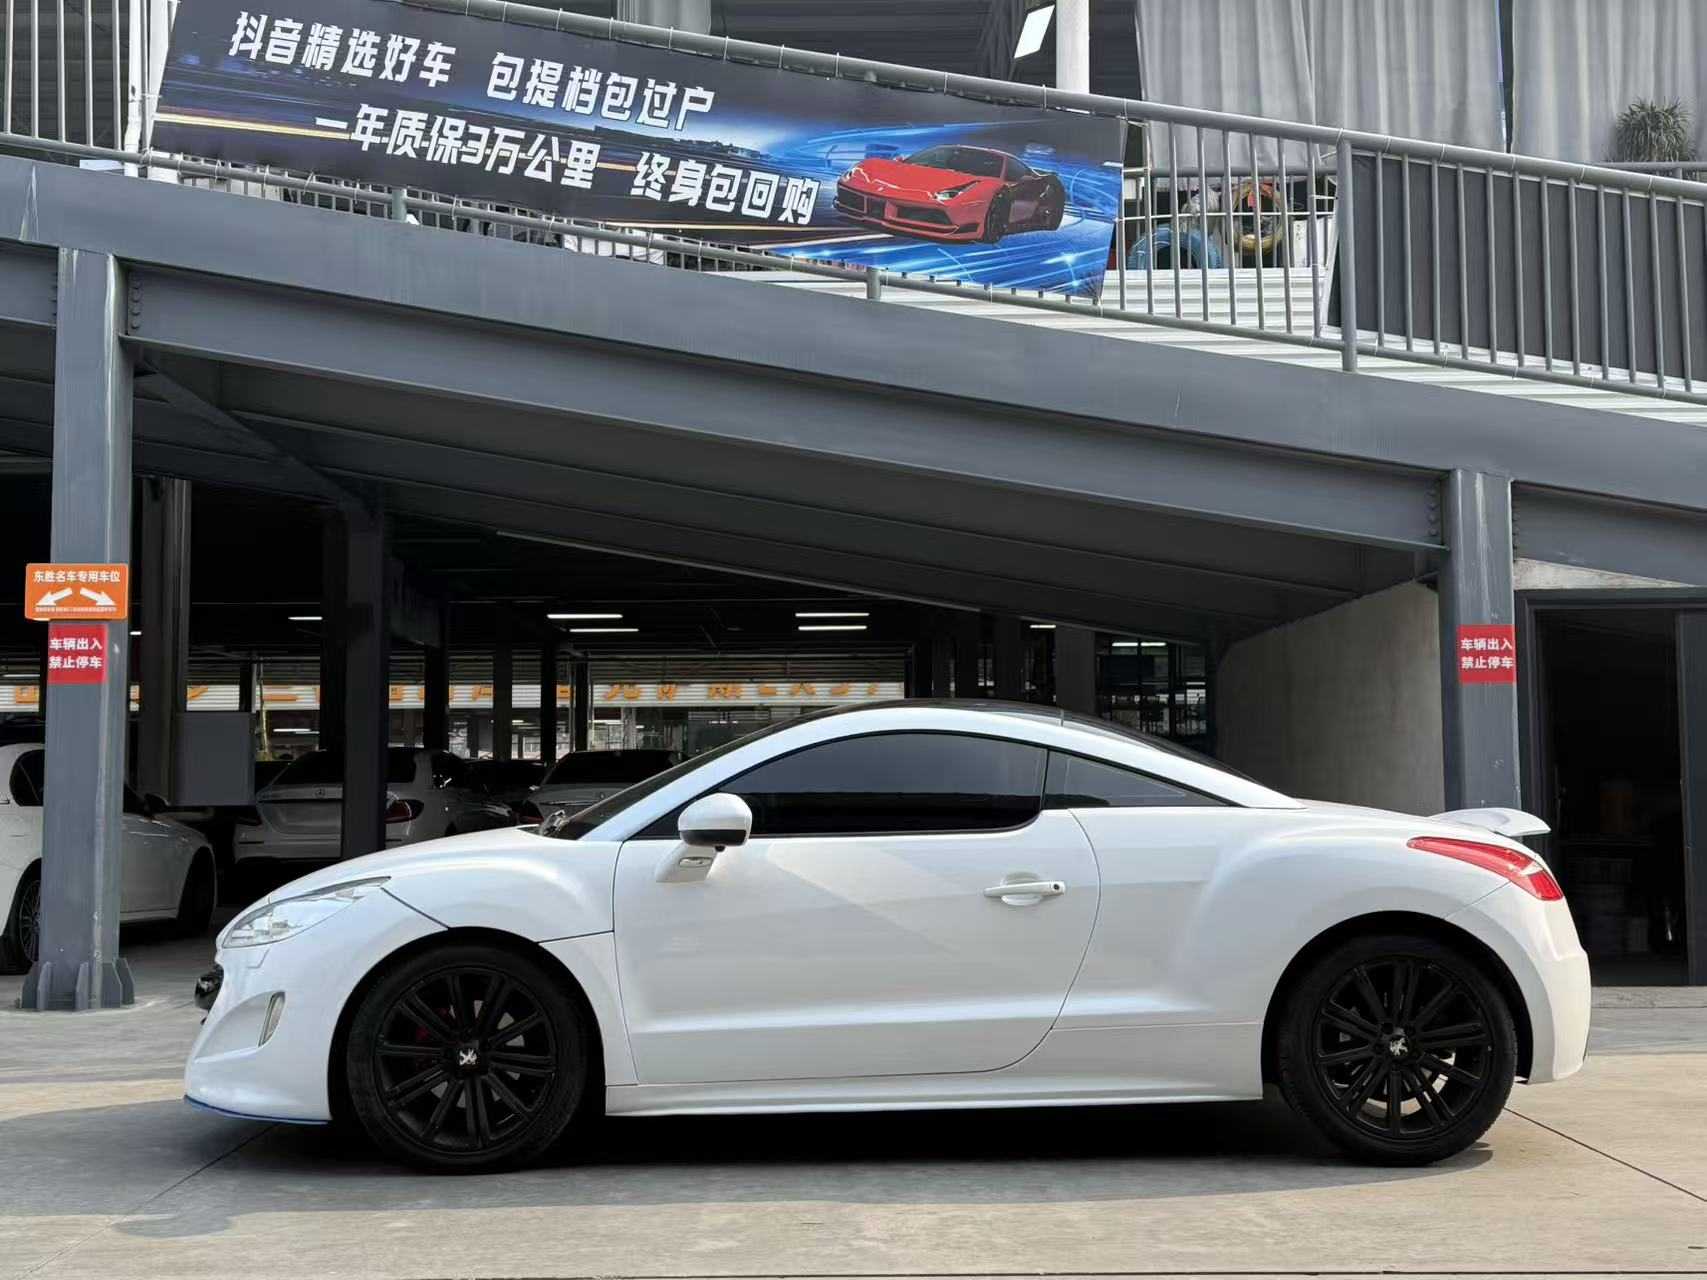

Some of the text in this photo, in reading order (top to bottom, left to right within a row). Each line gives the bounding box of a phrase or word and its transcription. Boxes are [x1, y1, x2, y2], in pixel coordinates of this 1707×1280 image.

[229, 12, 716, 131] 抖音精选好车 包提档包过户
[315, 104, 819, 226] 一年质保3万公里 终身包回购
[49, 638, 103, 650] 车辆出入
[1461, 638, 1513, 651] 车辆出入
[48, 657, 102, 669] 禁止停车
[1462, 657, 1514, 669] 禁止停车
